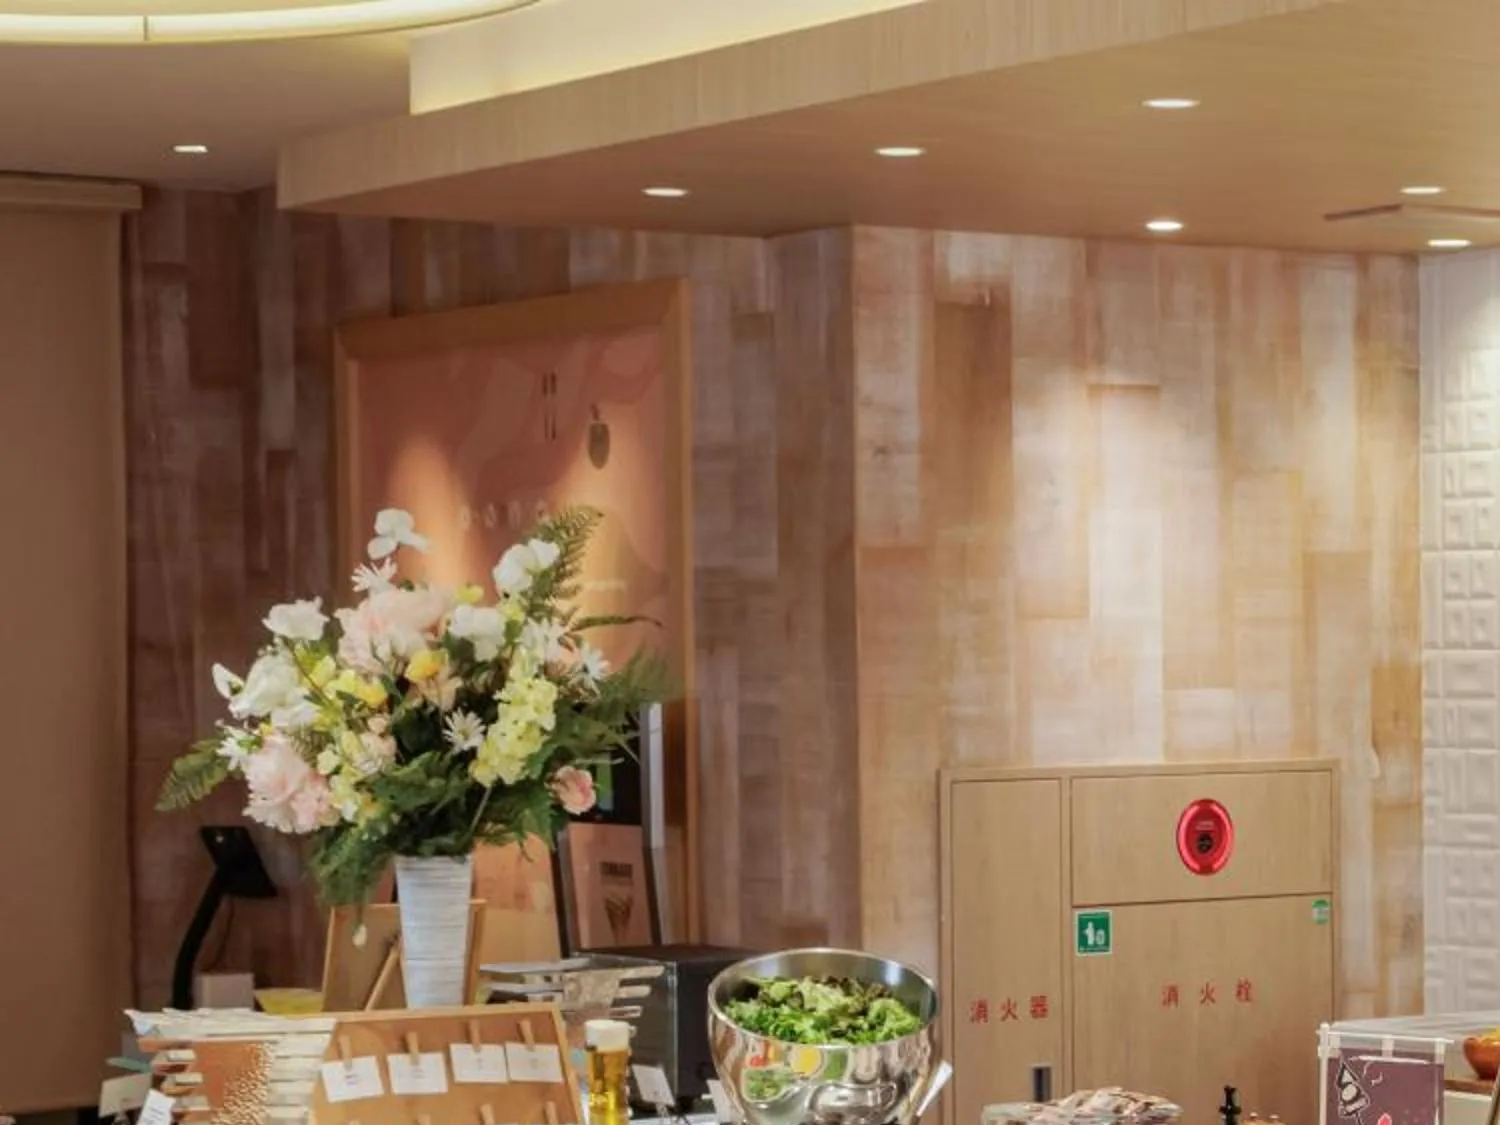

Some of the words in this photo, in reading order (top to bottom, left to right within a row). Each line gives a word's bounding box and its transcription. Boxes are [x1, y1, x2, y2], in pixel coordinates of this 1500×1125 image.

[1162, 977, 1252, 1008] 消火栓
[969, 994, 1049, 1024] 消火器
